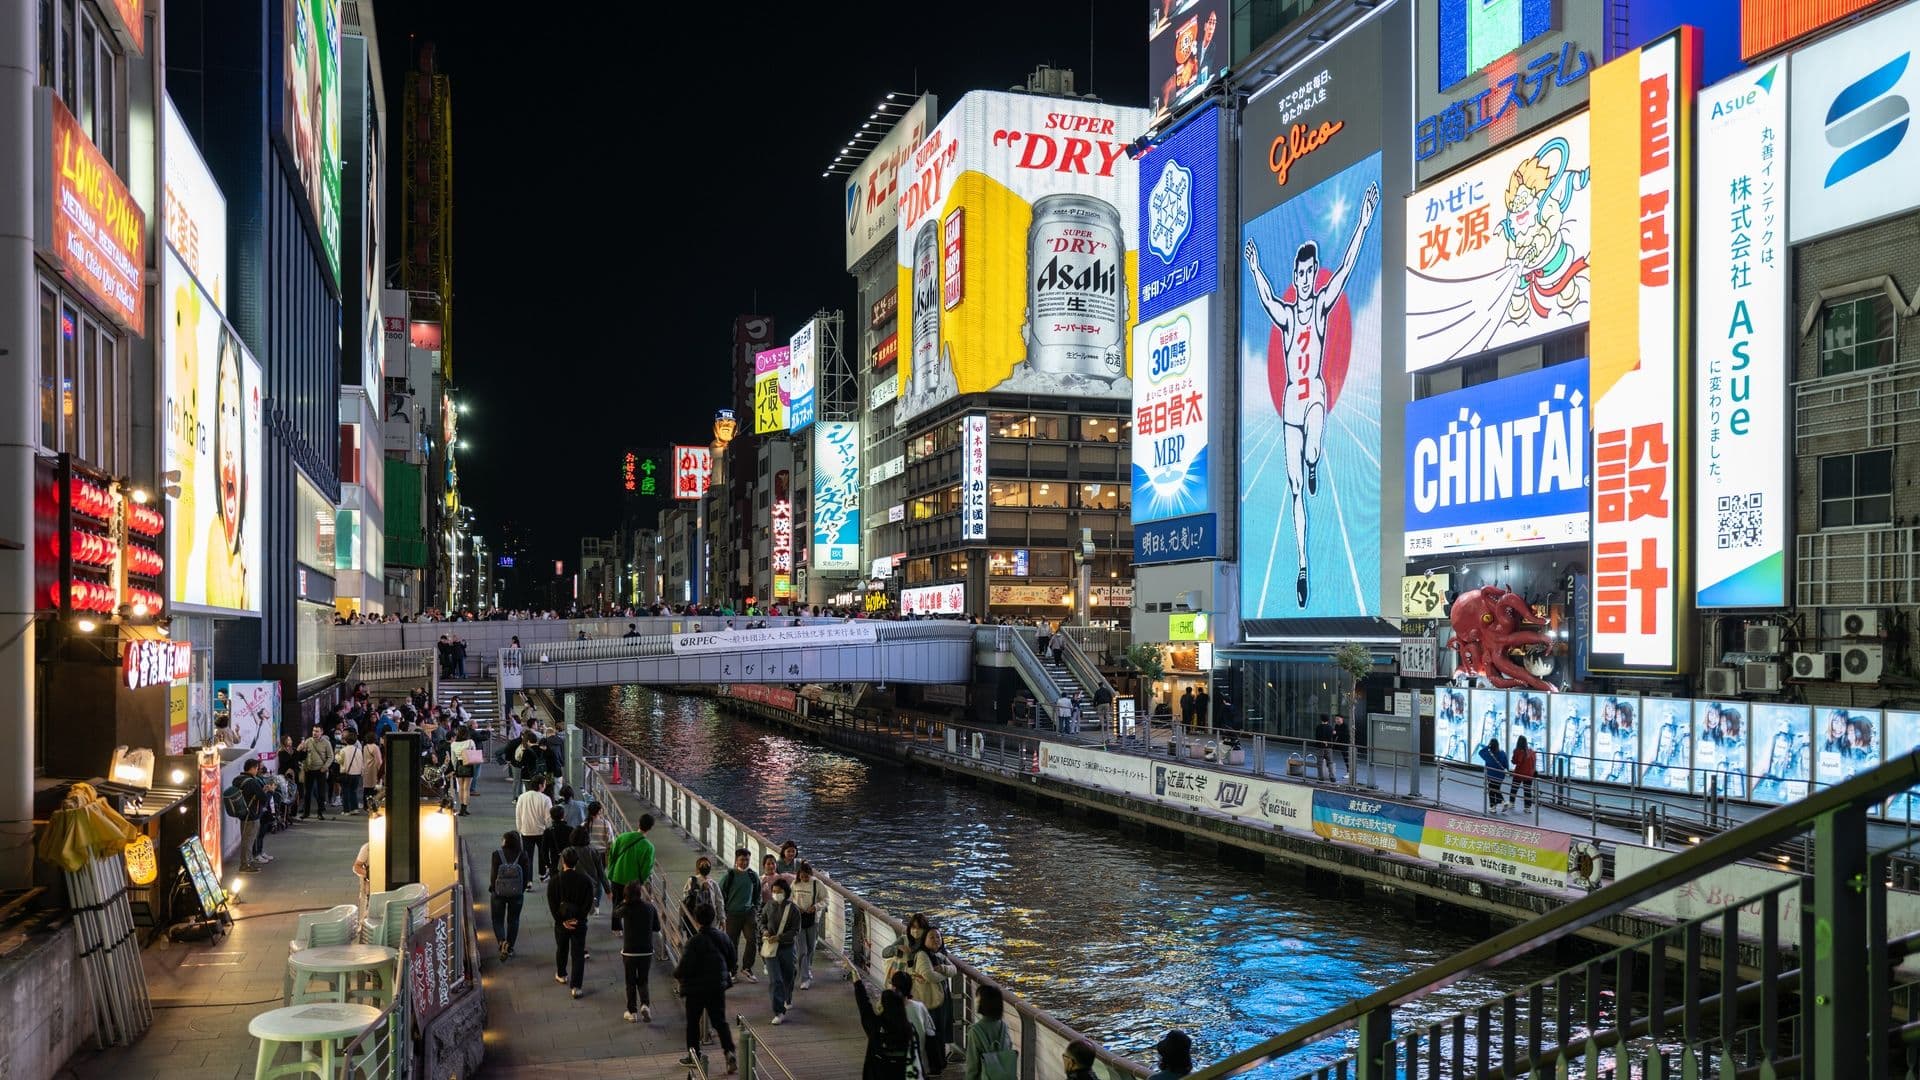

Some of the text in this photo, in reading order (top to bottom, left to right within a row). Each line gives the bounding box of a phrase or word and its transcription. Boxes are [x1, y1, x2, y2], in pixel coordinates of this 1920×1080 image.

[1044, 112, 1115, 135] SUPER
[1282, 88, 1327, 125] ゆたかな人生
[1711, 90, 1757, 120] Asue
[915, 130, 942, 173] SUPER
[1269, 120, 1344, 186] Glico
[62, 129, 140, 258] LONG DINH
[1425, 181, 1484, 223] かぜに
[62, 186, 139, 284] VIETNAM RESTAURANT
[1063, 229, 1093, 238] SUPER
[1419, 203, 1491, 270] 改源
[1037, 254, 1116, 297] Asahi
[1142, 260, 1199, 302] 雪印メグミルク
[914, 277, 937, 324] Asahi
[1067, 296, 1087, 312] 生
[1728, 174, 1754, 435] 株式会社 Asue
[1054, 324, 1101, 335] スーパードライ
[1152, 340, 1187, 377] 30周年
[1297, 325, 1312, 401] グリコ
[758, 380, 768, 432] バイト
[768, 378, 779, 429] 高収入
[1146, 379, 1193, 402] まいにちほねぶと
[1137, 391, 1203, 436] 毎日骨太
[1709, 360, 1722, 484] に変わりました。
[1154, 434, 1185, 469] MBP
[1414, 384, 1584, 514] CHINTAI
[772, 499, 790, 571] 大阪王将
[1597, 422, 1669, 635] 設計
[1167, 769, 1208, 793] 近畿大学
[1268, 803, 1297, 819] BIG BLUE
